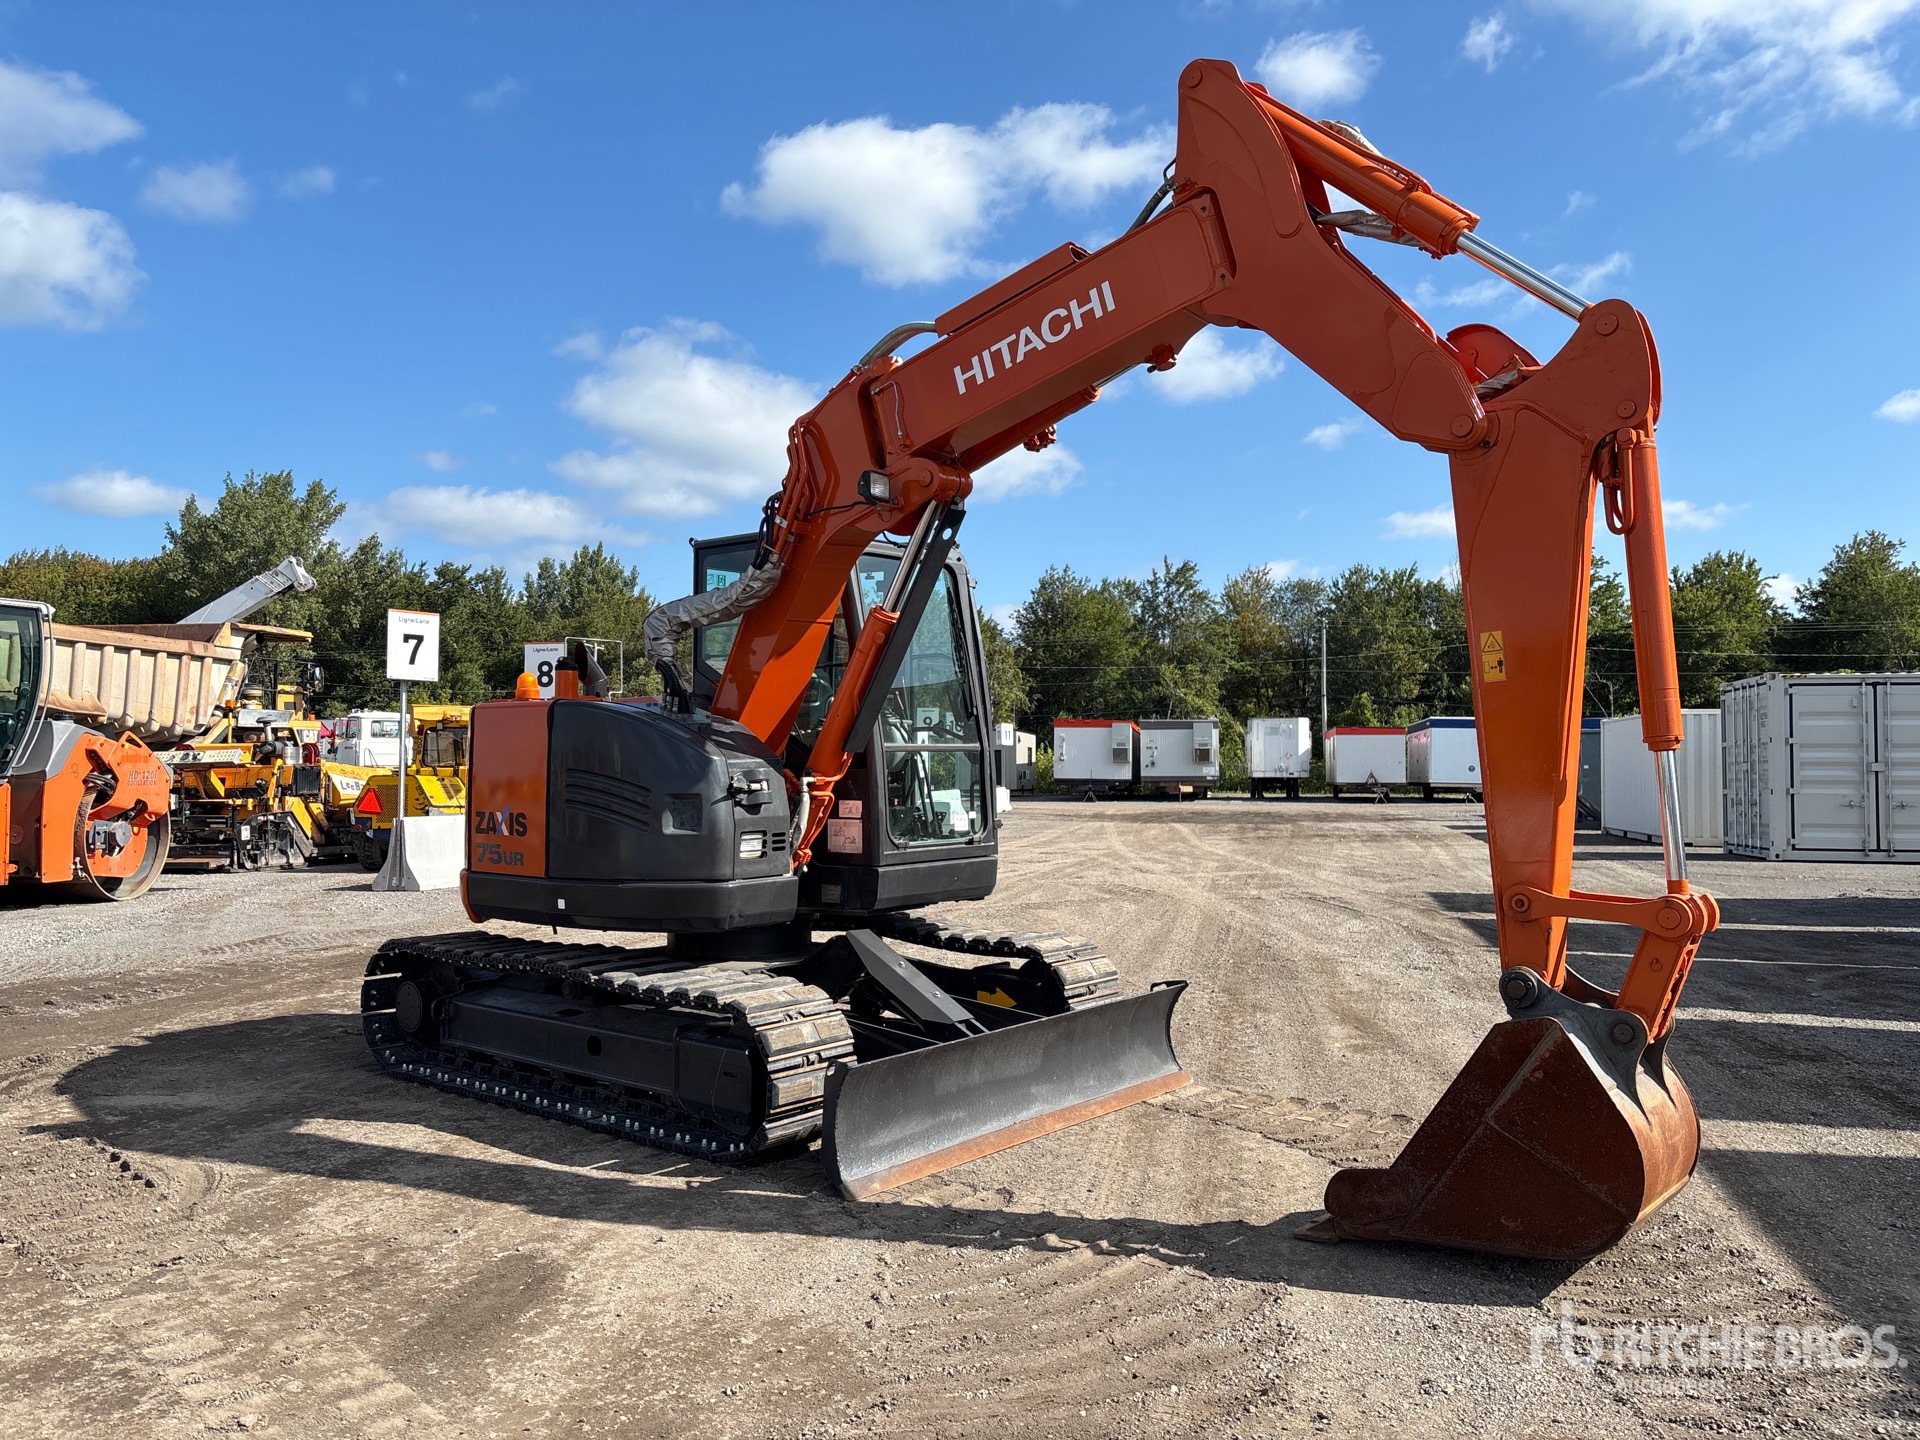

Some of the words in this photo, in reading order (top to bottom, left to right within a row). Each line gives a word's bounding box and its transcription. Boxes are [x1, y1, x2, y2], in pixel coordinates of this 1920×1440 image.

[953, 280, 1116, 395] HITACHI
[403, 633, 425, 666] 7
[537, 660, 554, 688] 8
[304, 730, 318, 743] CAT
[475, 806, 528, 837] ZAXIS
[474, 842, 525, 867] 75UR
